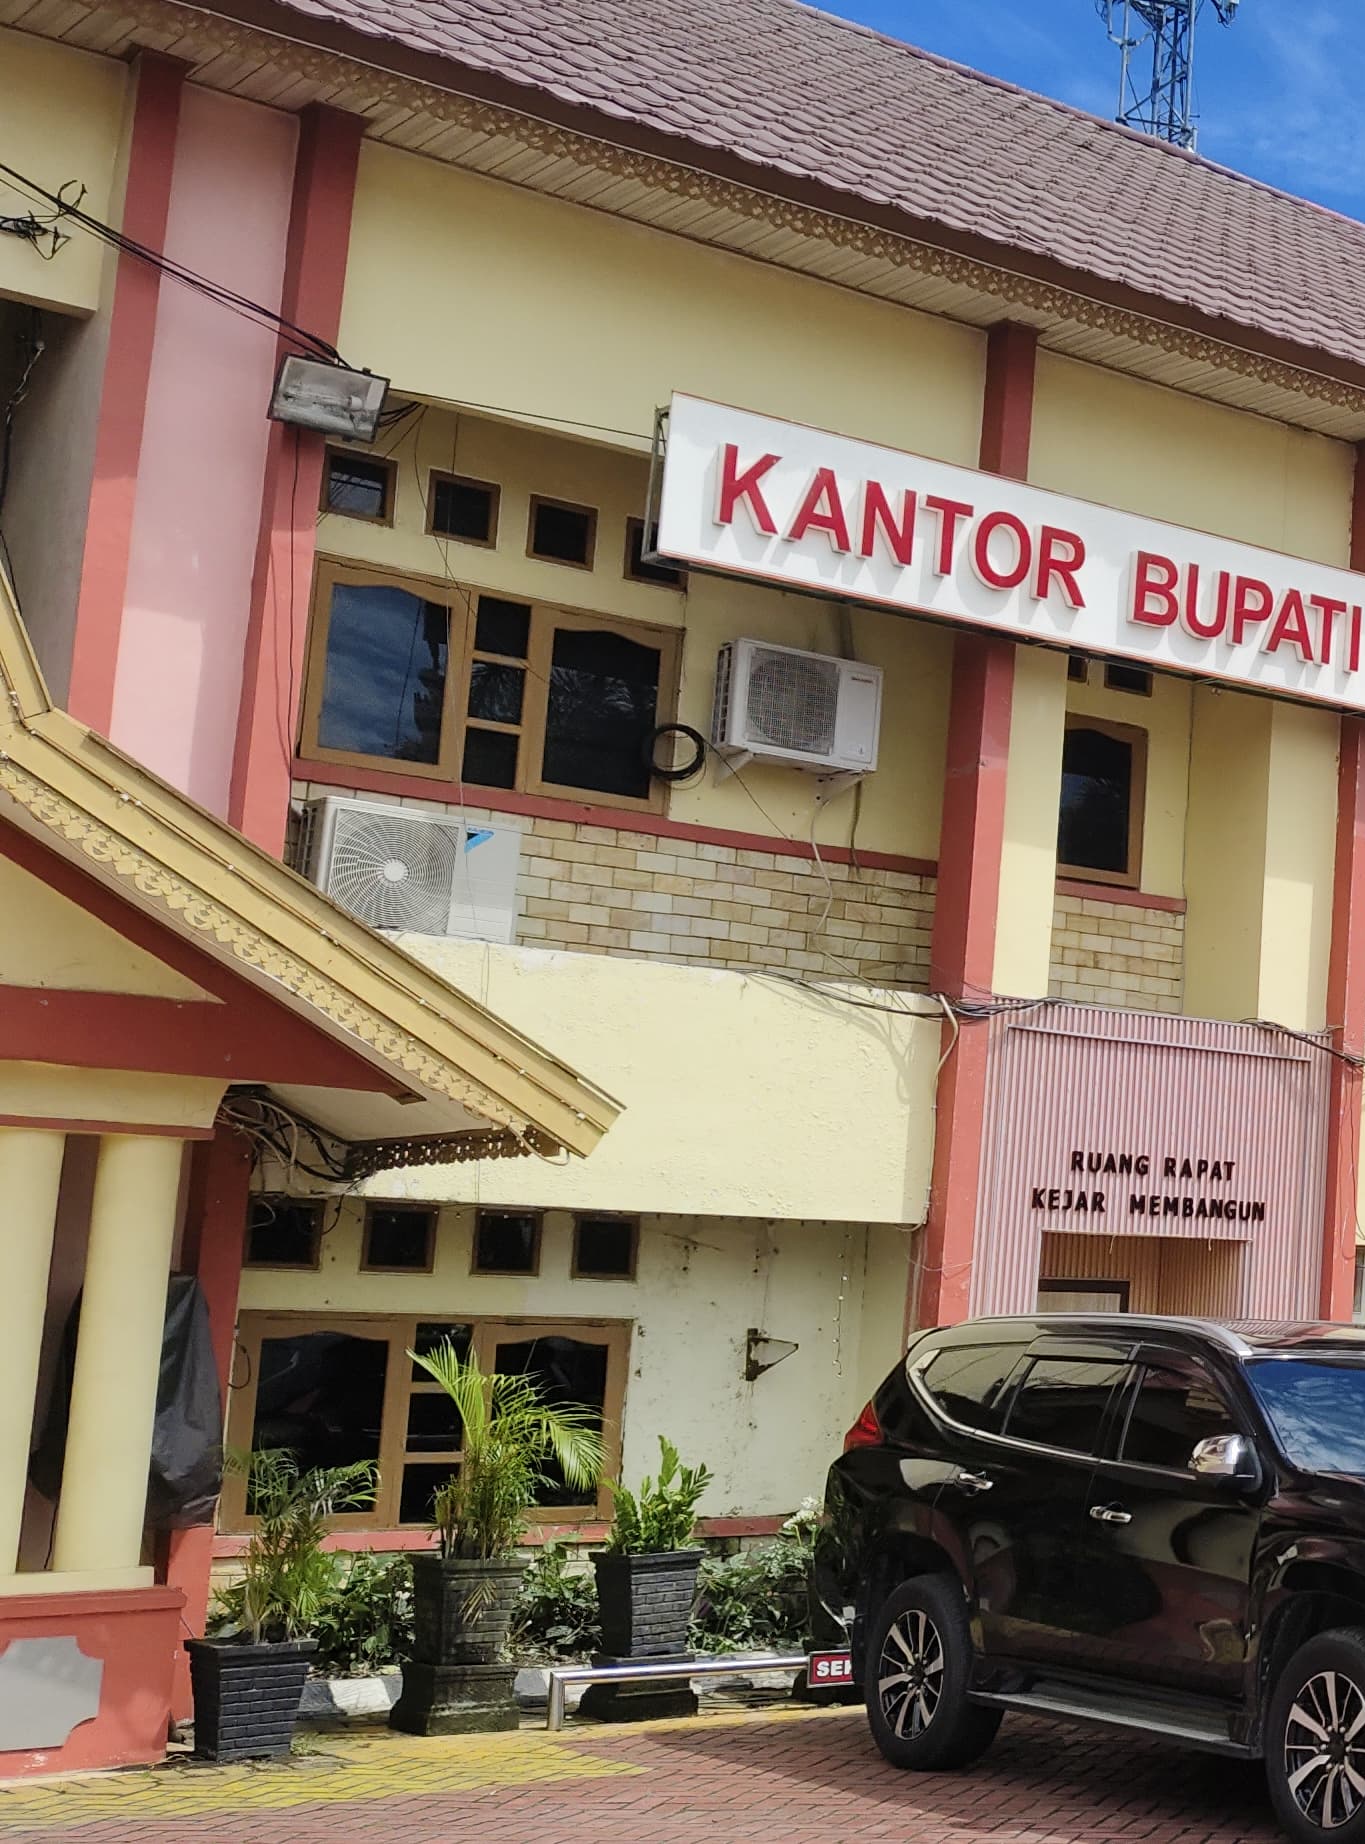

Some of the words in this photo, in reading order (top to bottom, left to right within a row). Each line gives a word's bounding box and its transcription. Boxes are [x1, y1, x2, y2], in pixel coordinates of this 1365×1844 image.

[716, 442, 1086, 609] KANTOR
[1129, 550, 1362, 673] BUPATI
[1071, 1150, 1150, 1176] RUANG
[1163, 1156, 1236, 1181] RAPAT
[1031, 1187, 1106, 1213] KEJAR
[1129, 1193, 1266, 1222] MEMBANGUN
